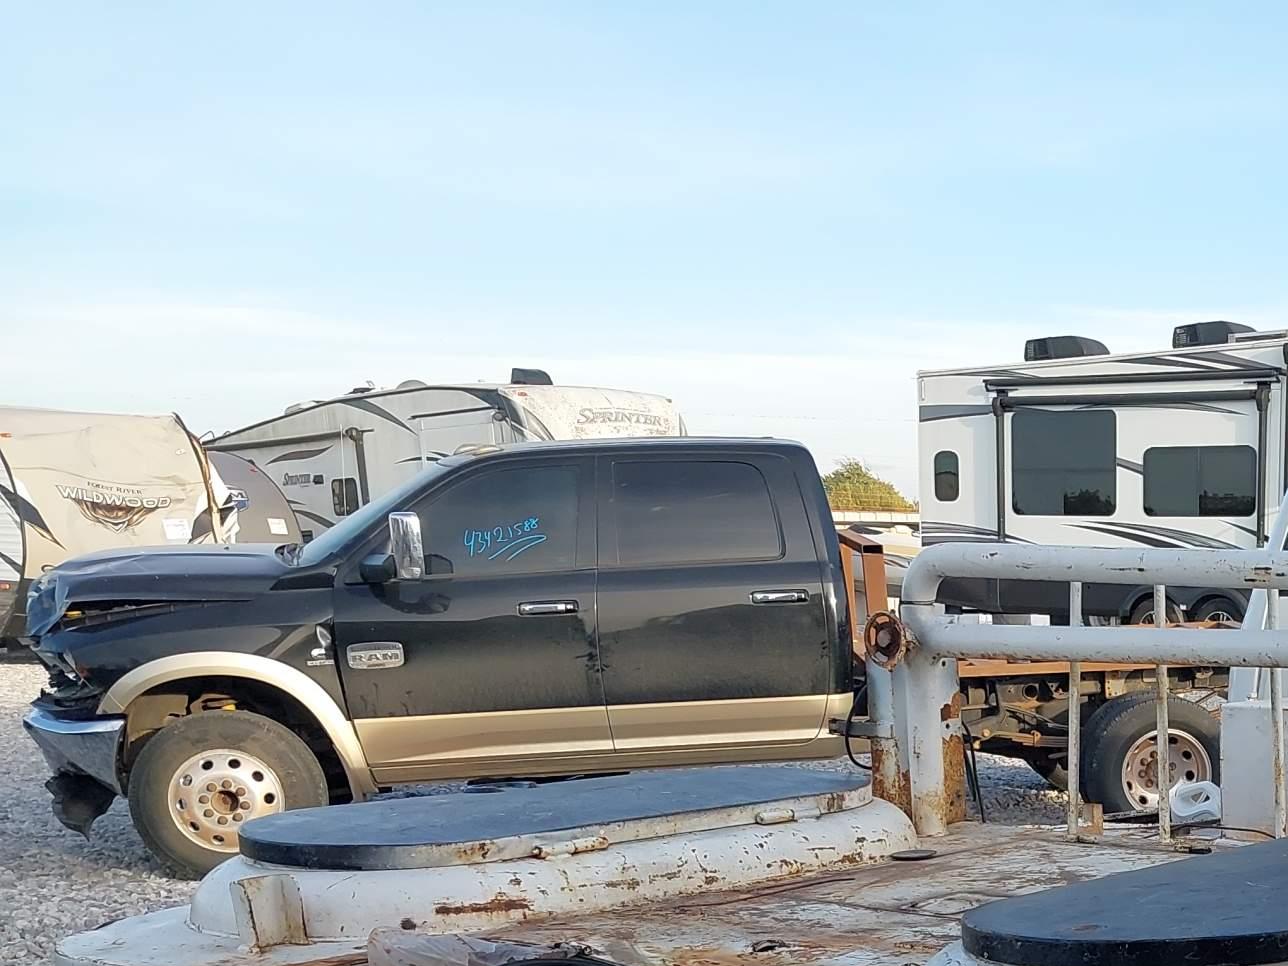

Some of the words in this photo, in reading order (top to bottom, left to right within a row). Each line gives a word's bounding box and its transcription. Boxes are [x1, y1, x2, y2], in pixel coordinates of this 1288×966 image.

[576, 408, 661, 427] SPRINTER
[56, 484, 171, 508] WILDWOOD
[116, 487, 142, 495] RIVER
[350, 651, 400, 662] RAM
